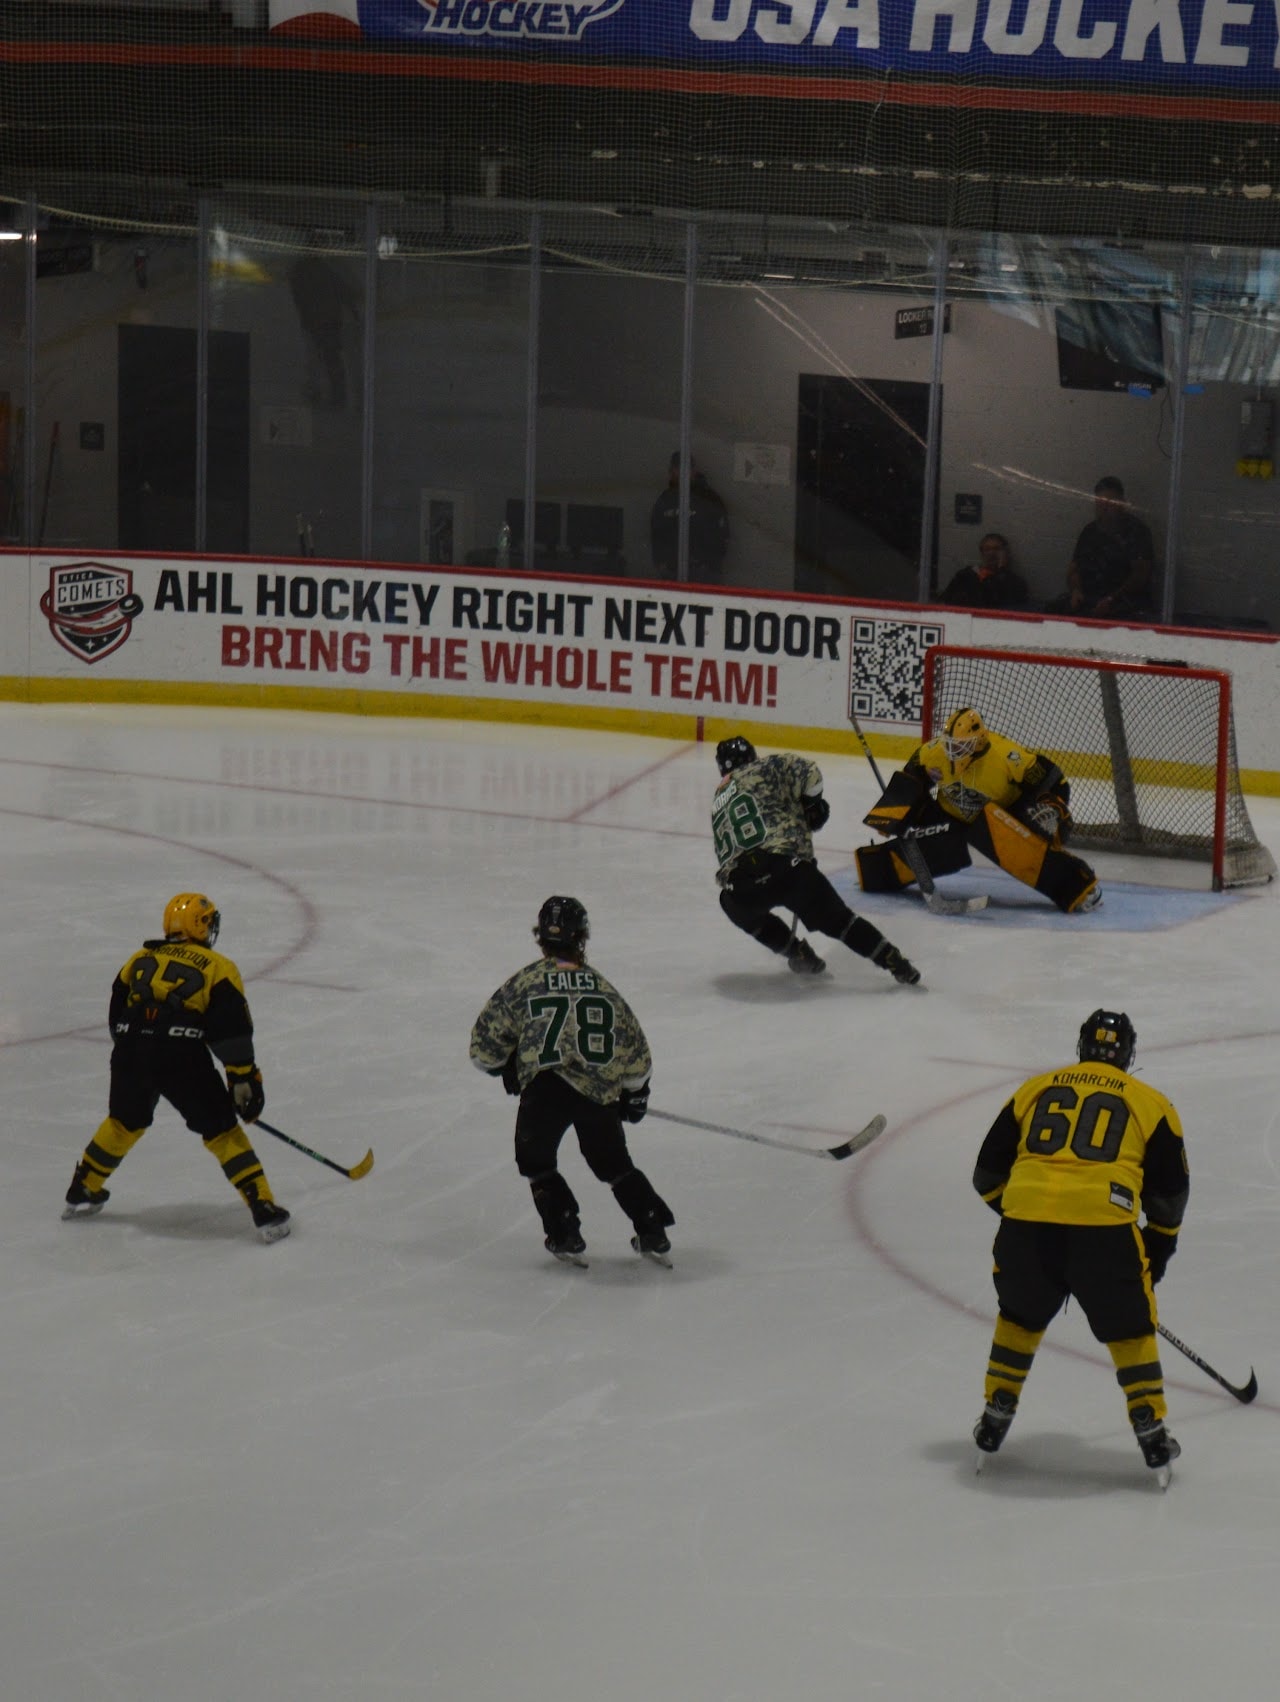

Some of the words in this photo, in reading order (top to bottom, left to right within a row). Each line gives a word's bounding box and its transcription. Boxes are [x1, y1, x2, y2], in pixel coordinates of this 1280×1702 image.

[431, 0, 592, 36] HOCKEY
[58, 578, 125, 603] COMETS
[154, 570, 243, 614] AHL
[256, 575, 440, 626] HOCKEY
[453, 586, 593, 637] RIGHT
[605, 597, 713, 648] NEXT
[724, 608, 841, 660] DOOR
[221, 625, 371, 673] BRING
[383, 634, 468, 681] THE
[481, 640, 633, 694] WHOLE
[645, 653, 777, 708] TEAM!
[712, 792, 767, 868] 58
[915, 822, 950, 839] CCM
[547, 972, 596, 991] EALES
[527, 994, 616, 1068] 78
[1026, 1085, 1131, 1163] 60
